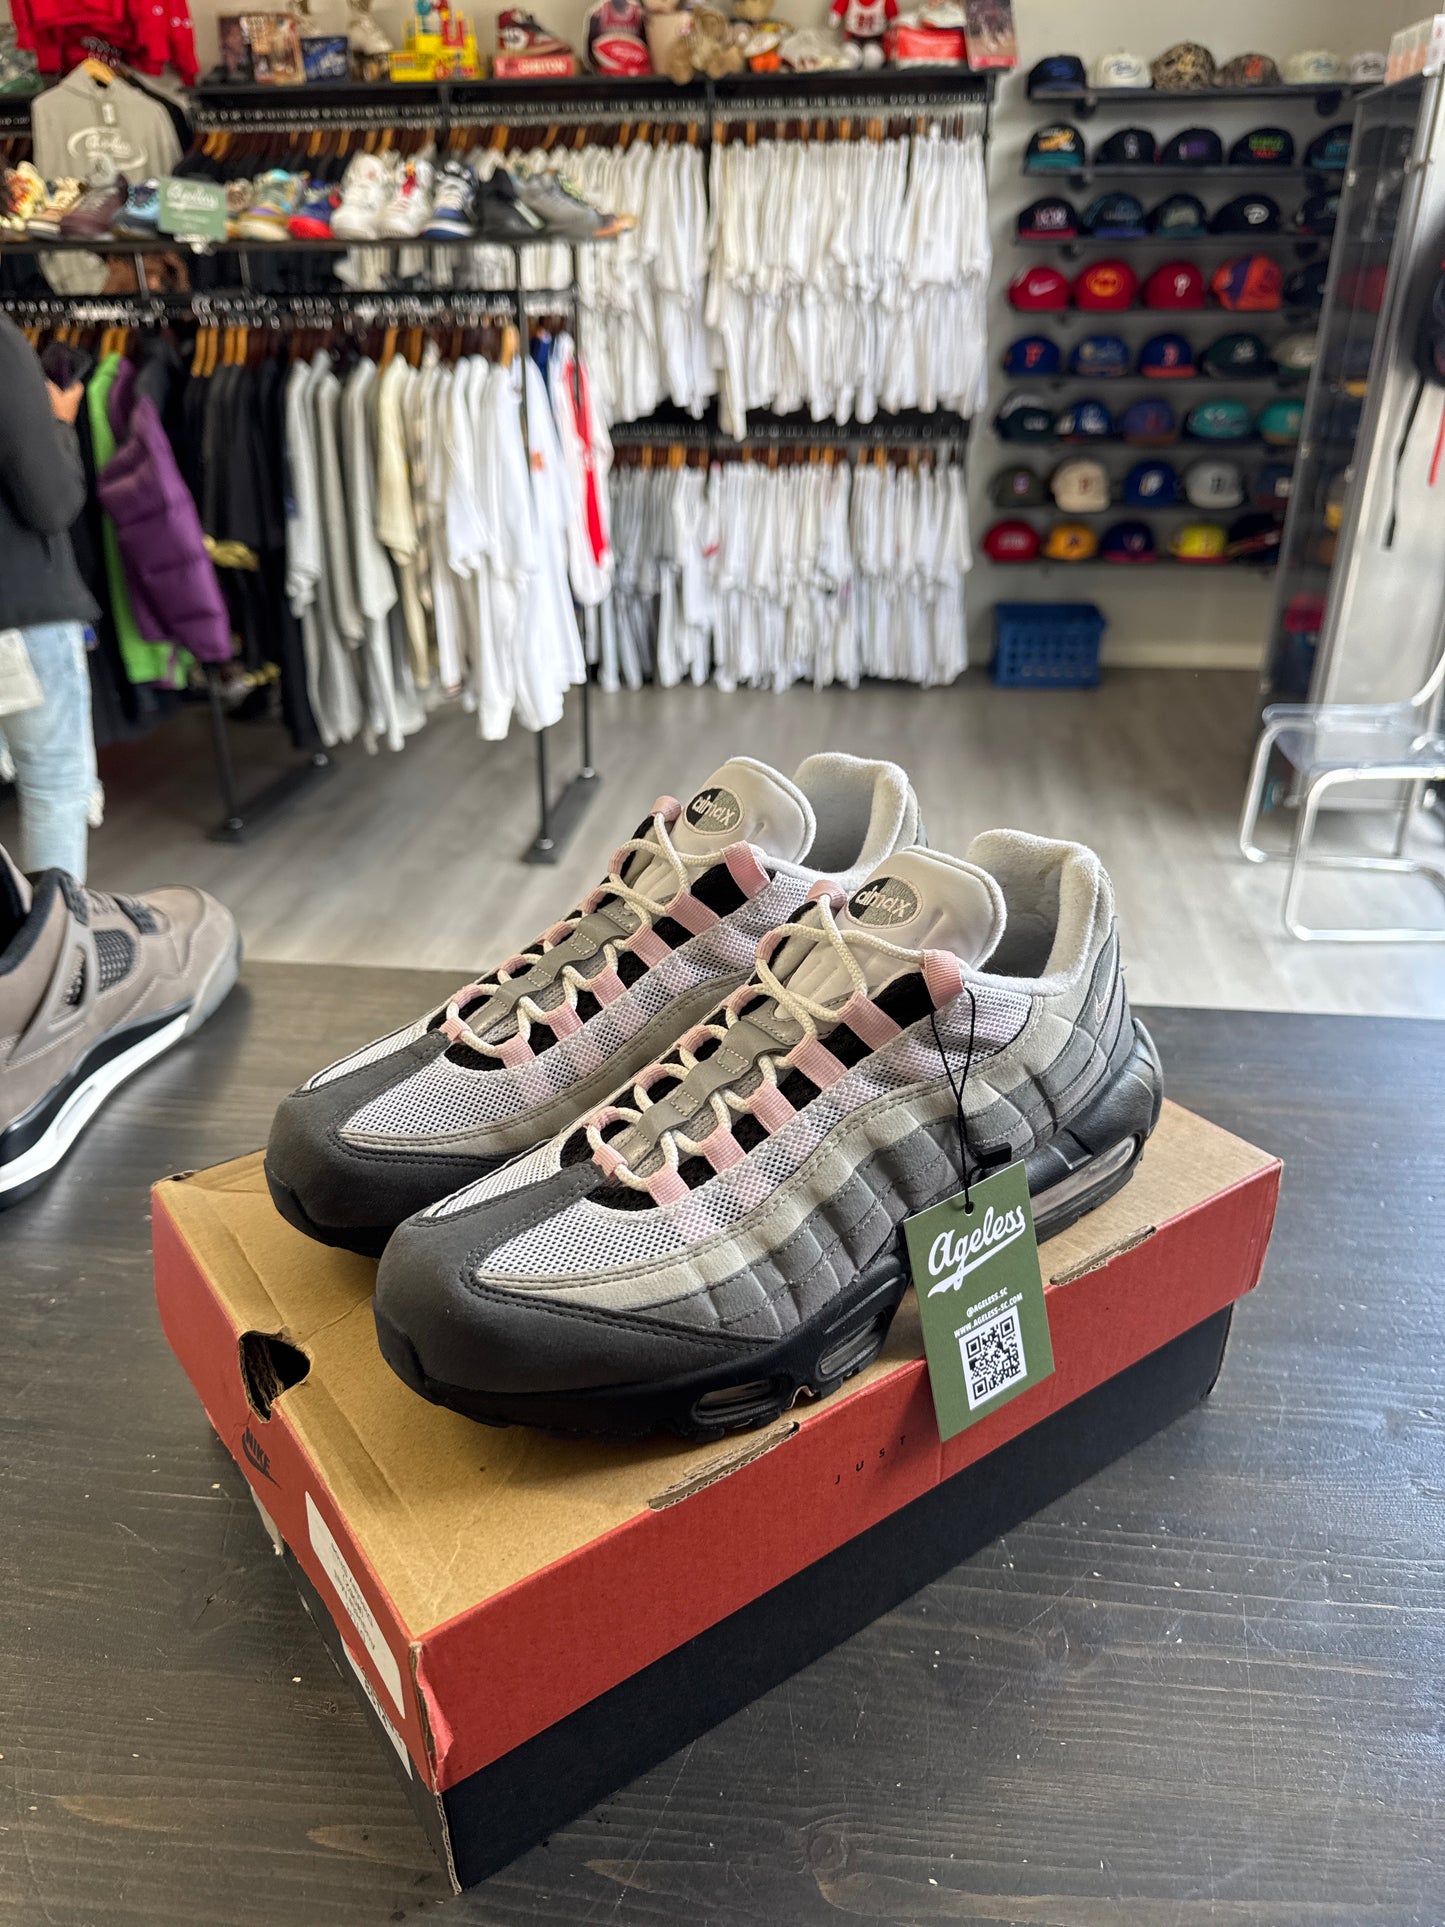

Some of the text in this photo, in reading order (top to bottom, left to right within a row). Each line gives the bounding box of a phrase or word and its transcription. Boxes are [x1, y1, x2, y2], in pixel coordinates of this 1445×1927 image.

[928, 1205, 1026, 1292] Ageless
[953, 1292, 1024, 1339] WWW.AGELESS-SC.COM
[966, 1286, 1009, 1319] @AGELESS.SC
[244, 1426, 271, 1472] NIKE
[834, 1434, 907, 1486] JUST
